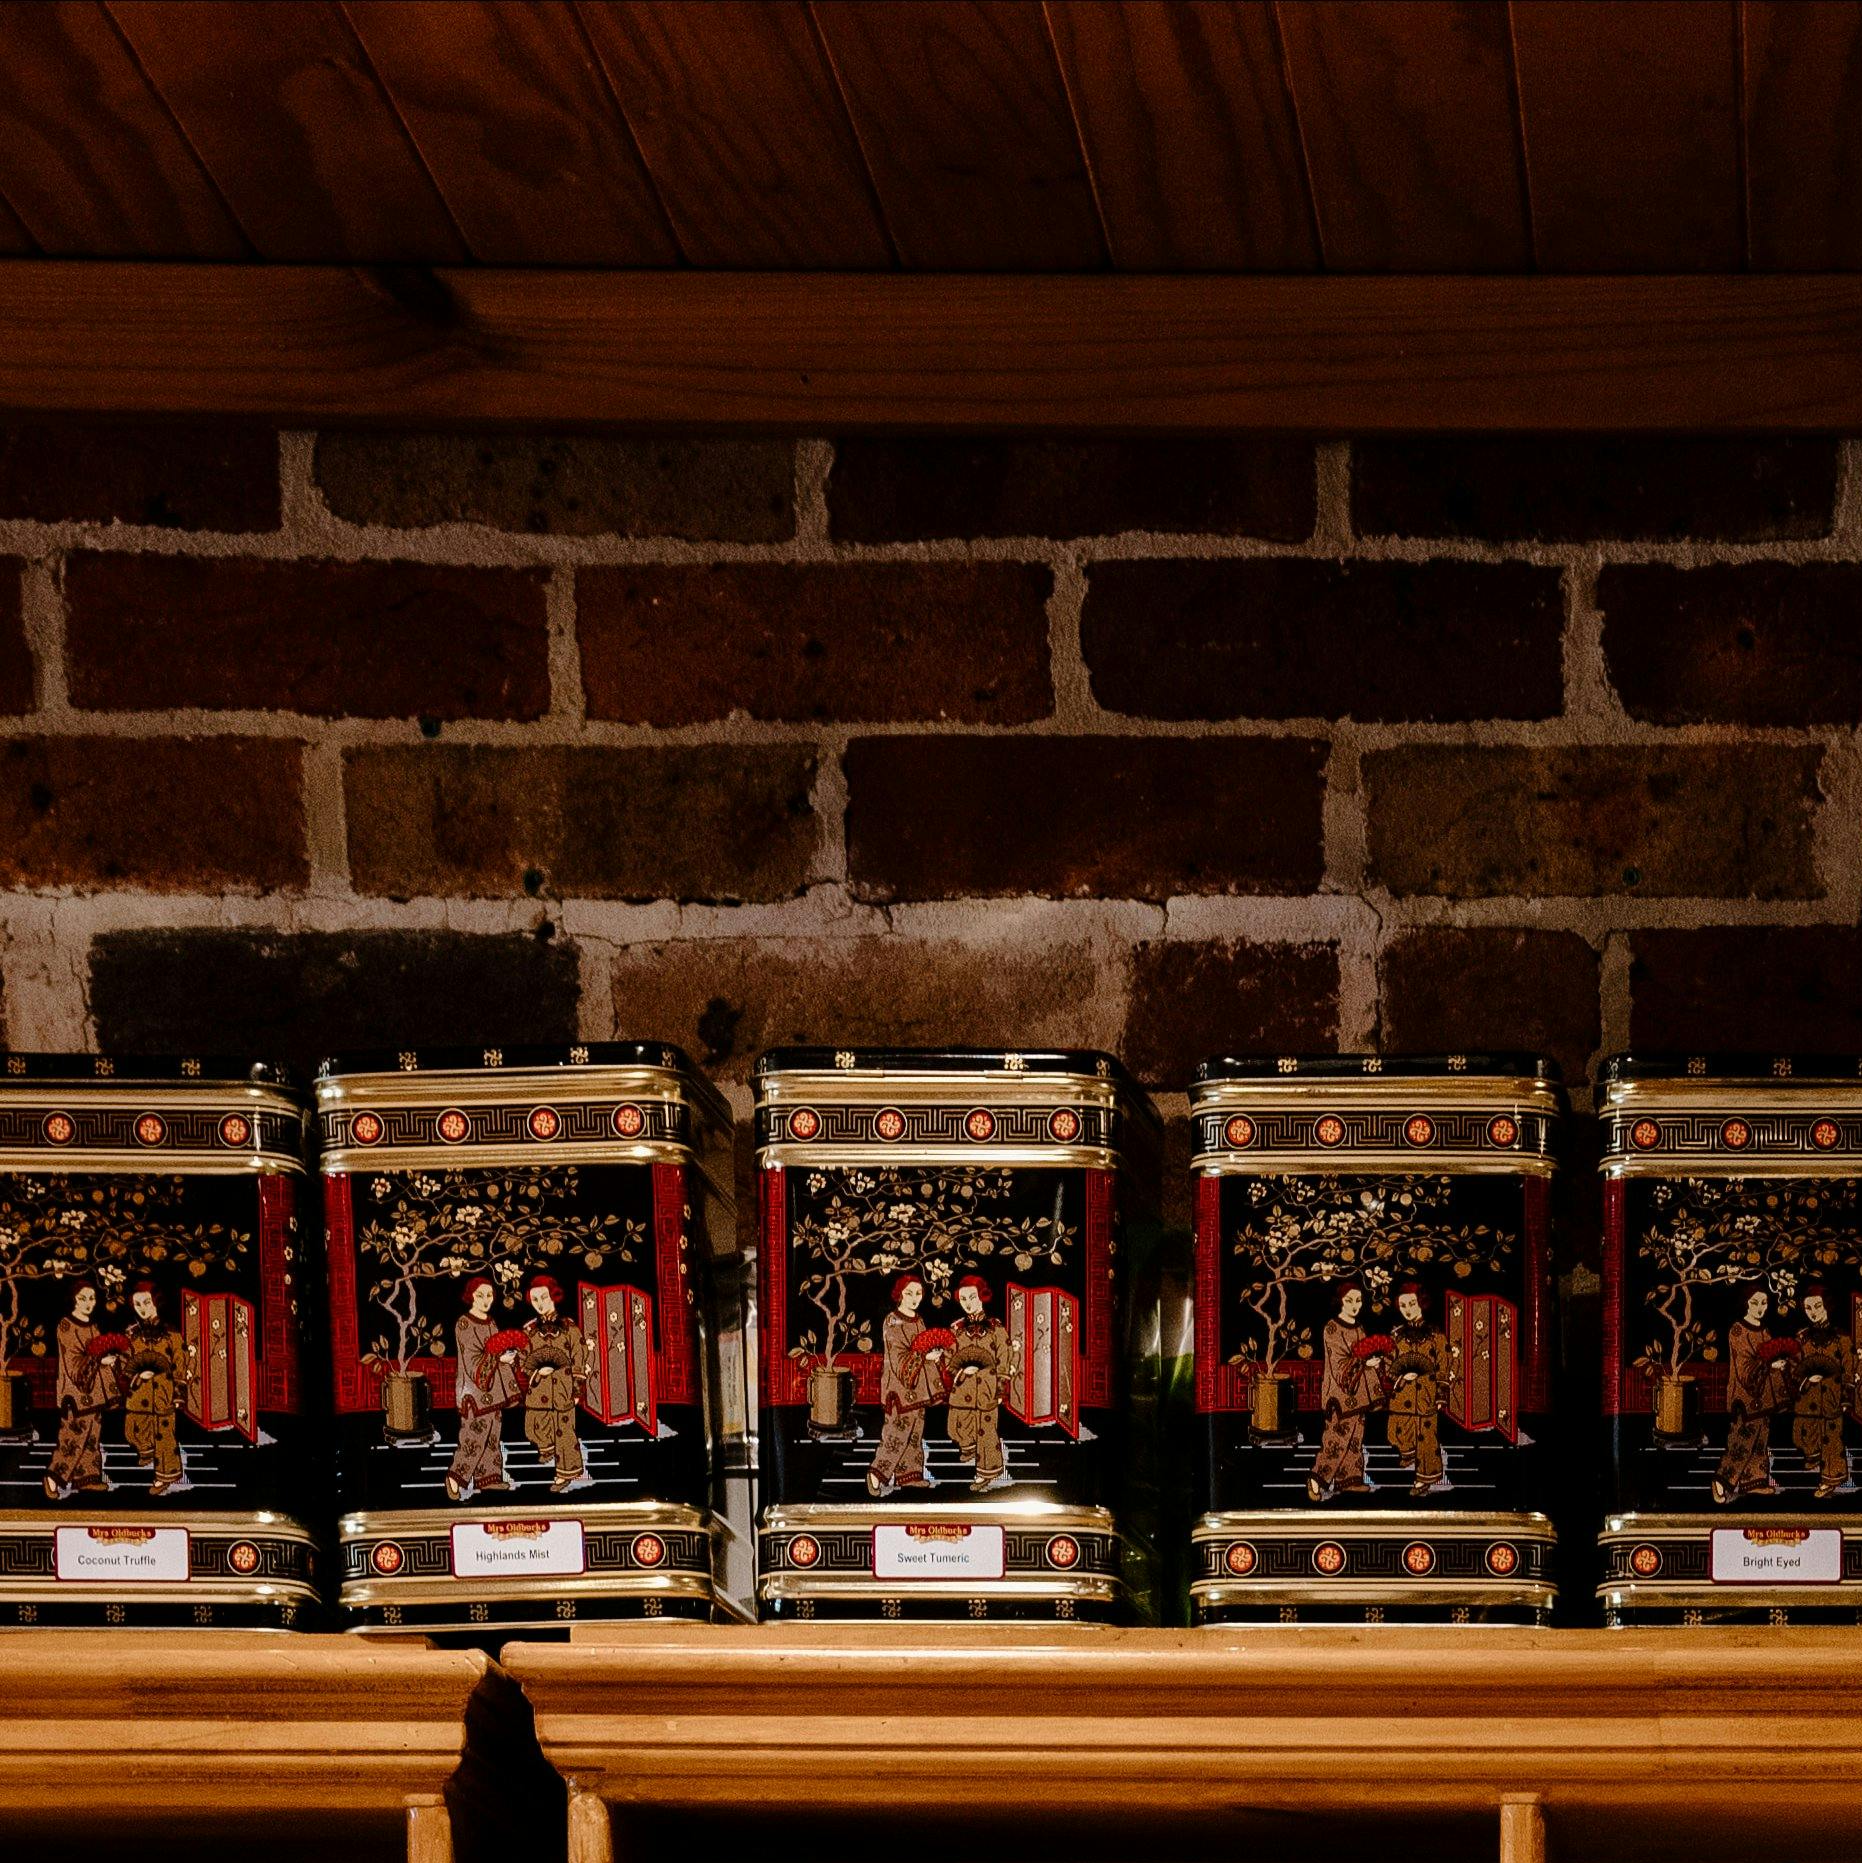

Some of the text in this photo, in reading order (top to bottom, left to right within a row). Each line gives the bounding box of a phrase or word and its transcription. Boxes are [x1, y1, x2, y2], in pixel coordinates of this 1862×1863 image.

[508, 1523, 546, 1531] Oldbucks
[92, 1528, 151, 1538] Mrs Oldbucks
[1766, 1529, 1805, 1538] Oldbucks
[78, 1556, 155, 1565] Coconut Truffle
[477, 1550, 549, 1562] Highlands Mist
[898, 1553, 969, 1562] Sweet Tumeric
[1744, 1557, 1800, 1569] Bright Eyed
